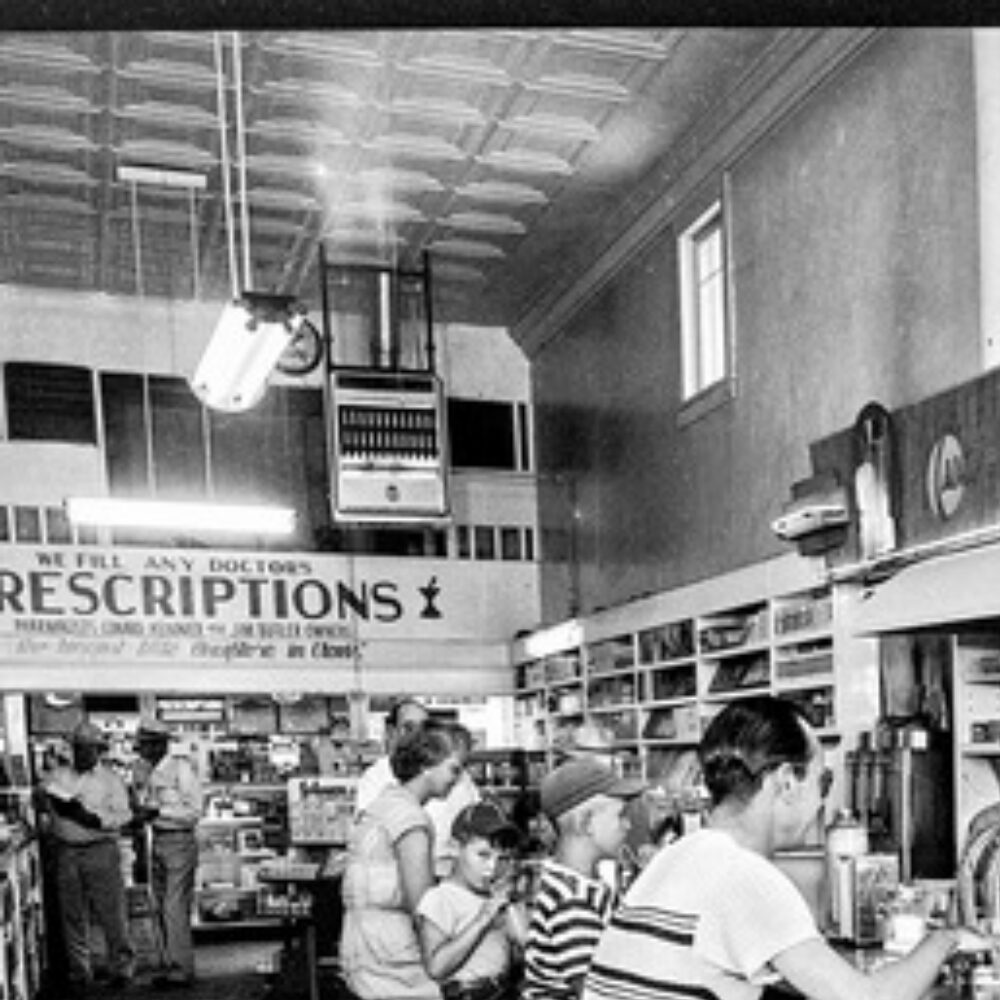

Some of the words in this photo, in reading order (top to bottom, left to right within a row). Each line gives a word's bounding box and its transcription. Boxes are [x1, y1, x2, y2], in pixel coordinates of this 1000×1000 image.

[36, 552, 65, 568] WE
[76, 552, 123, 569] FILL
[145, 555, 194, 572] ANY
